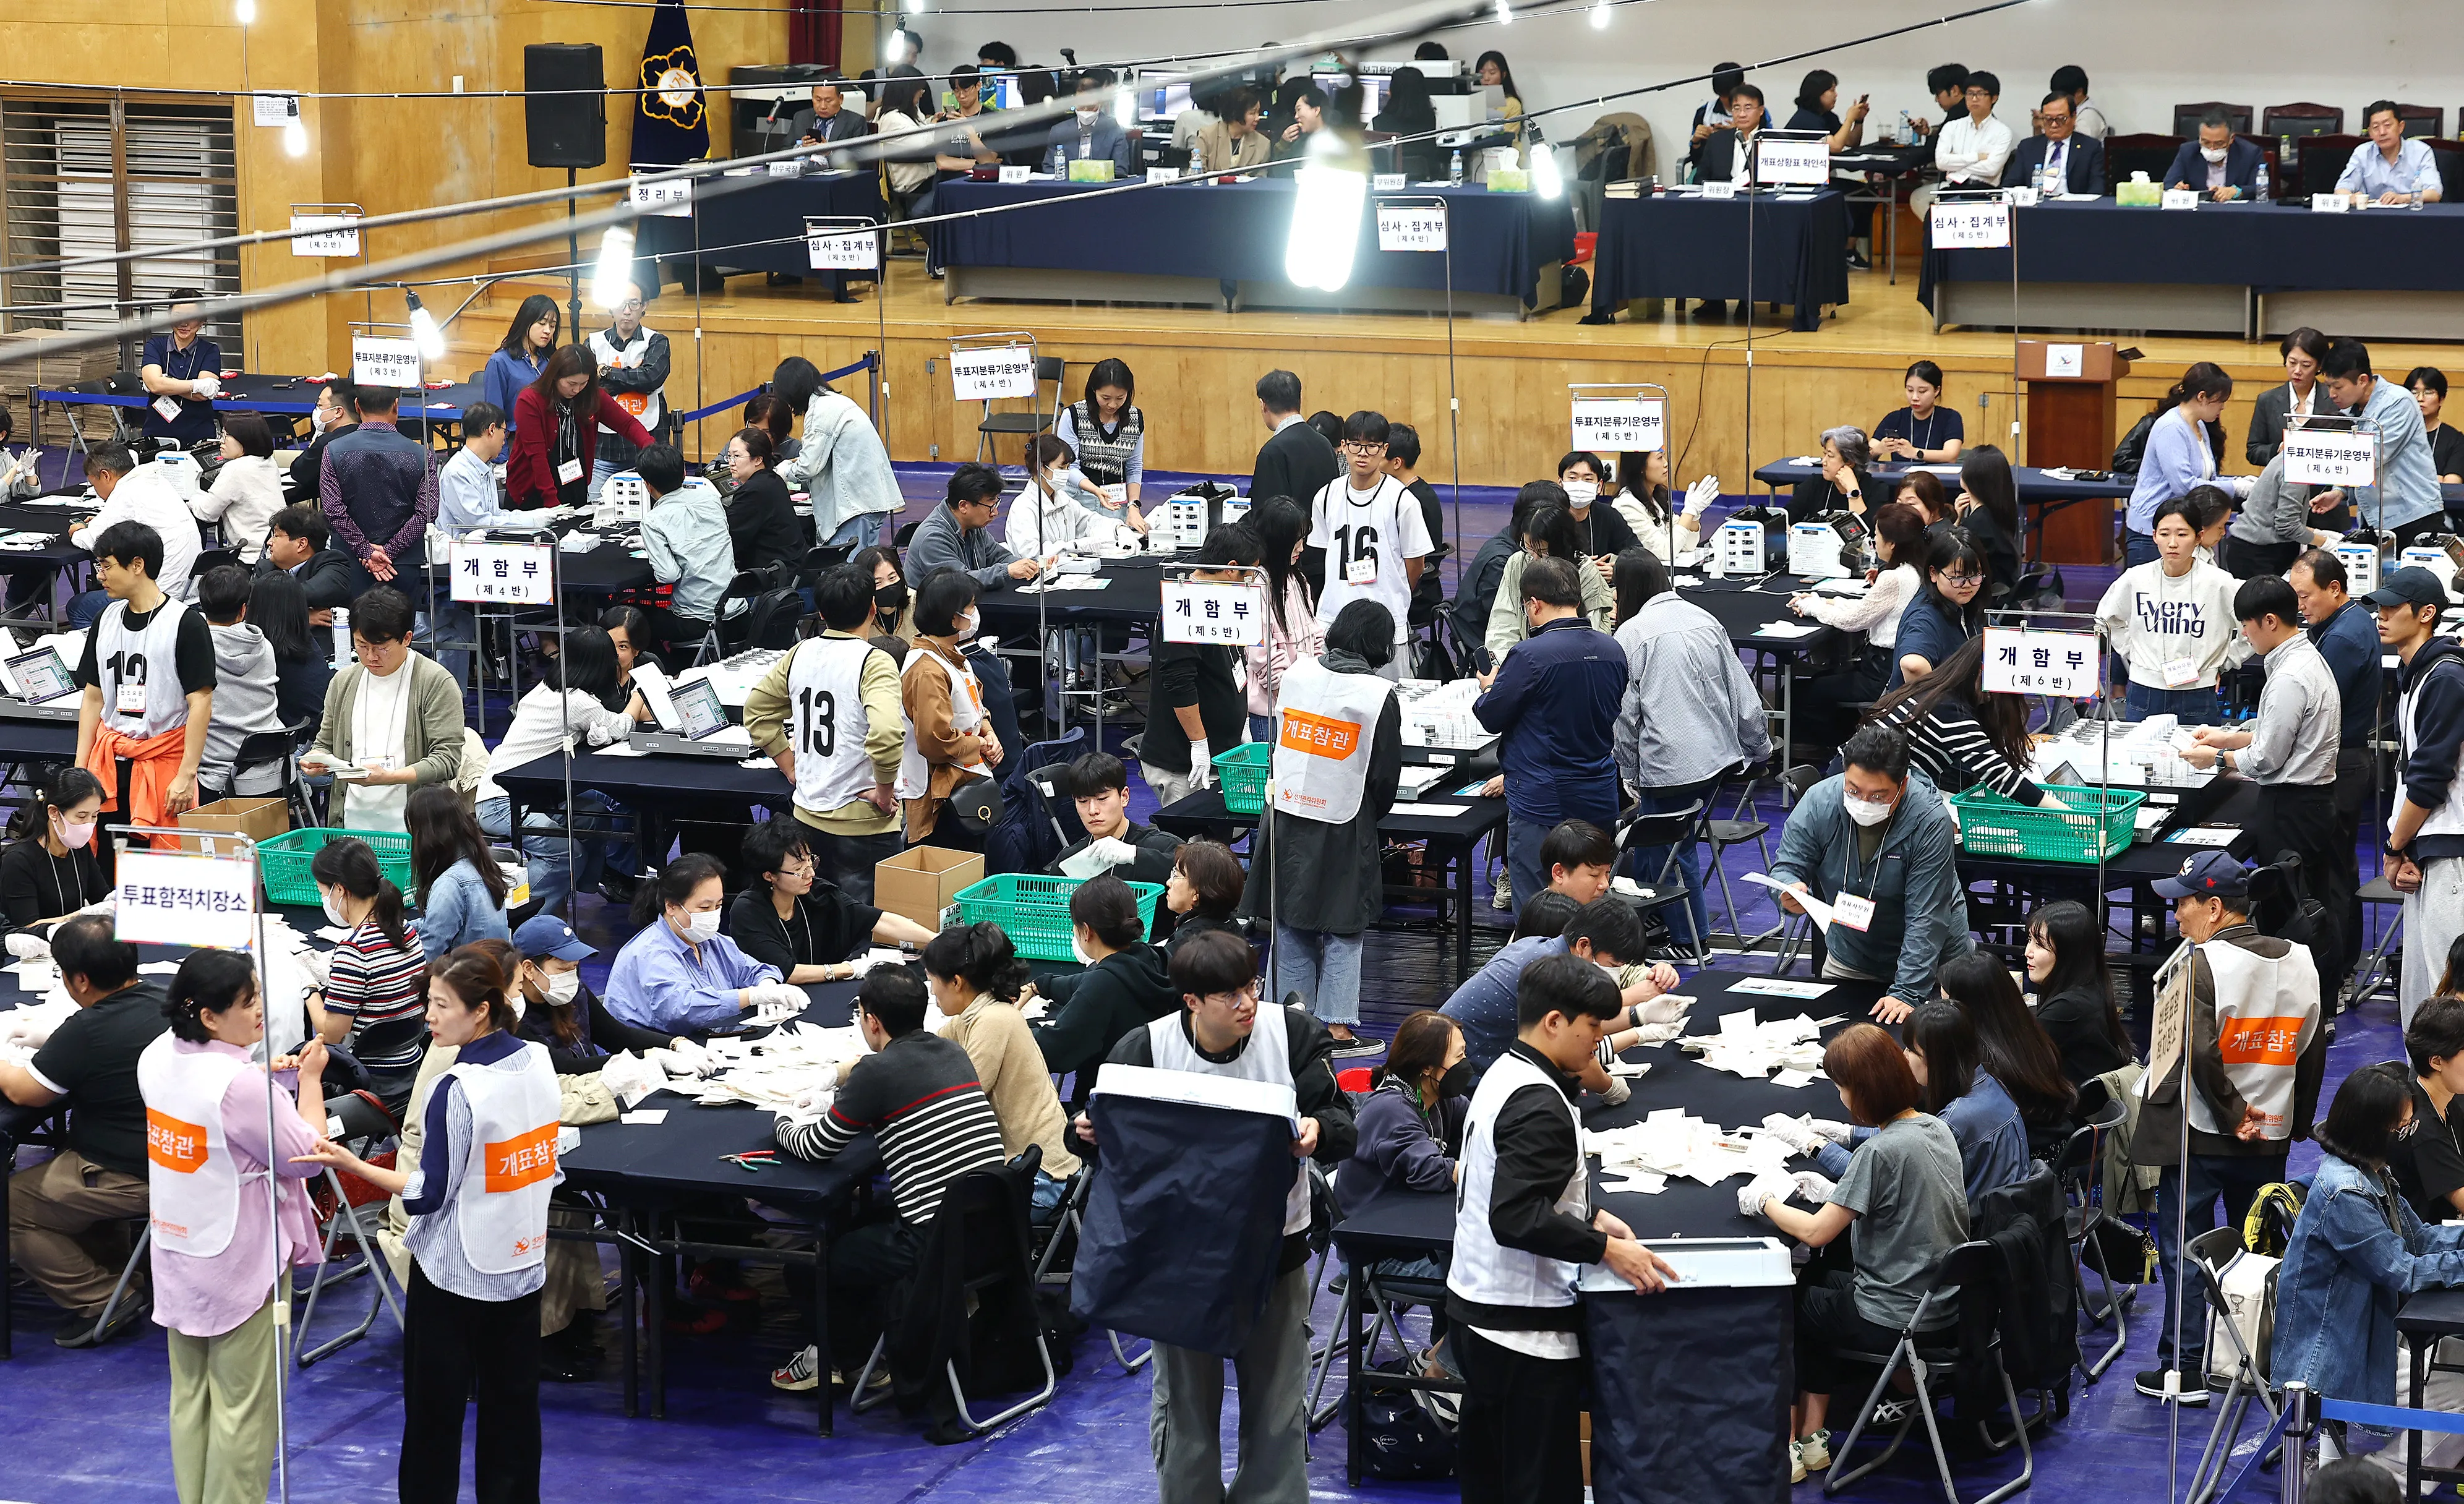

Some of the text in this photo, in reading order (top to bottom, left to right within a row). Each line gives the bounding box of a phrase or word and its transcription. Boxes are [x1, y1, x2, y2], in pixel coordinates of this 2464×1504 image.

[1761, 157, 1827, 168] 개표상황표 확인석
[355, 352, 417, 365] 투표지분류기운영부
[954, 362, 1030, 377] 투표지분류기운영부
[1575, 416, 1661, 427] 투표지분류기운영부
[2286, 446, 2372, 462] 투표지분류기운영부
[1334, 524, 1379, 581] 16
[2136, 592, 2205, 620] Every
[2144, 608, 2205, 639] thing
[799, 686, 835, 758] 13
[1286, 719, 1350, 751] 개표참관
[1294, 793, 1327, 806] 선거관리위원회
[121, 884, 248, 912] 투표함적치장소
